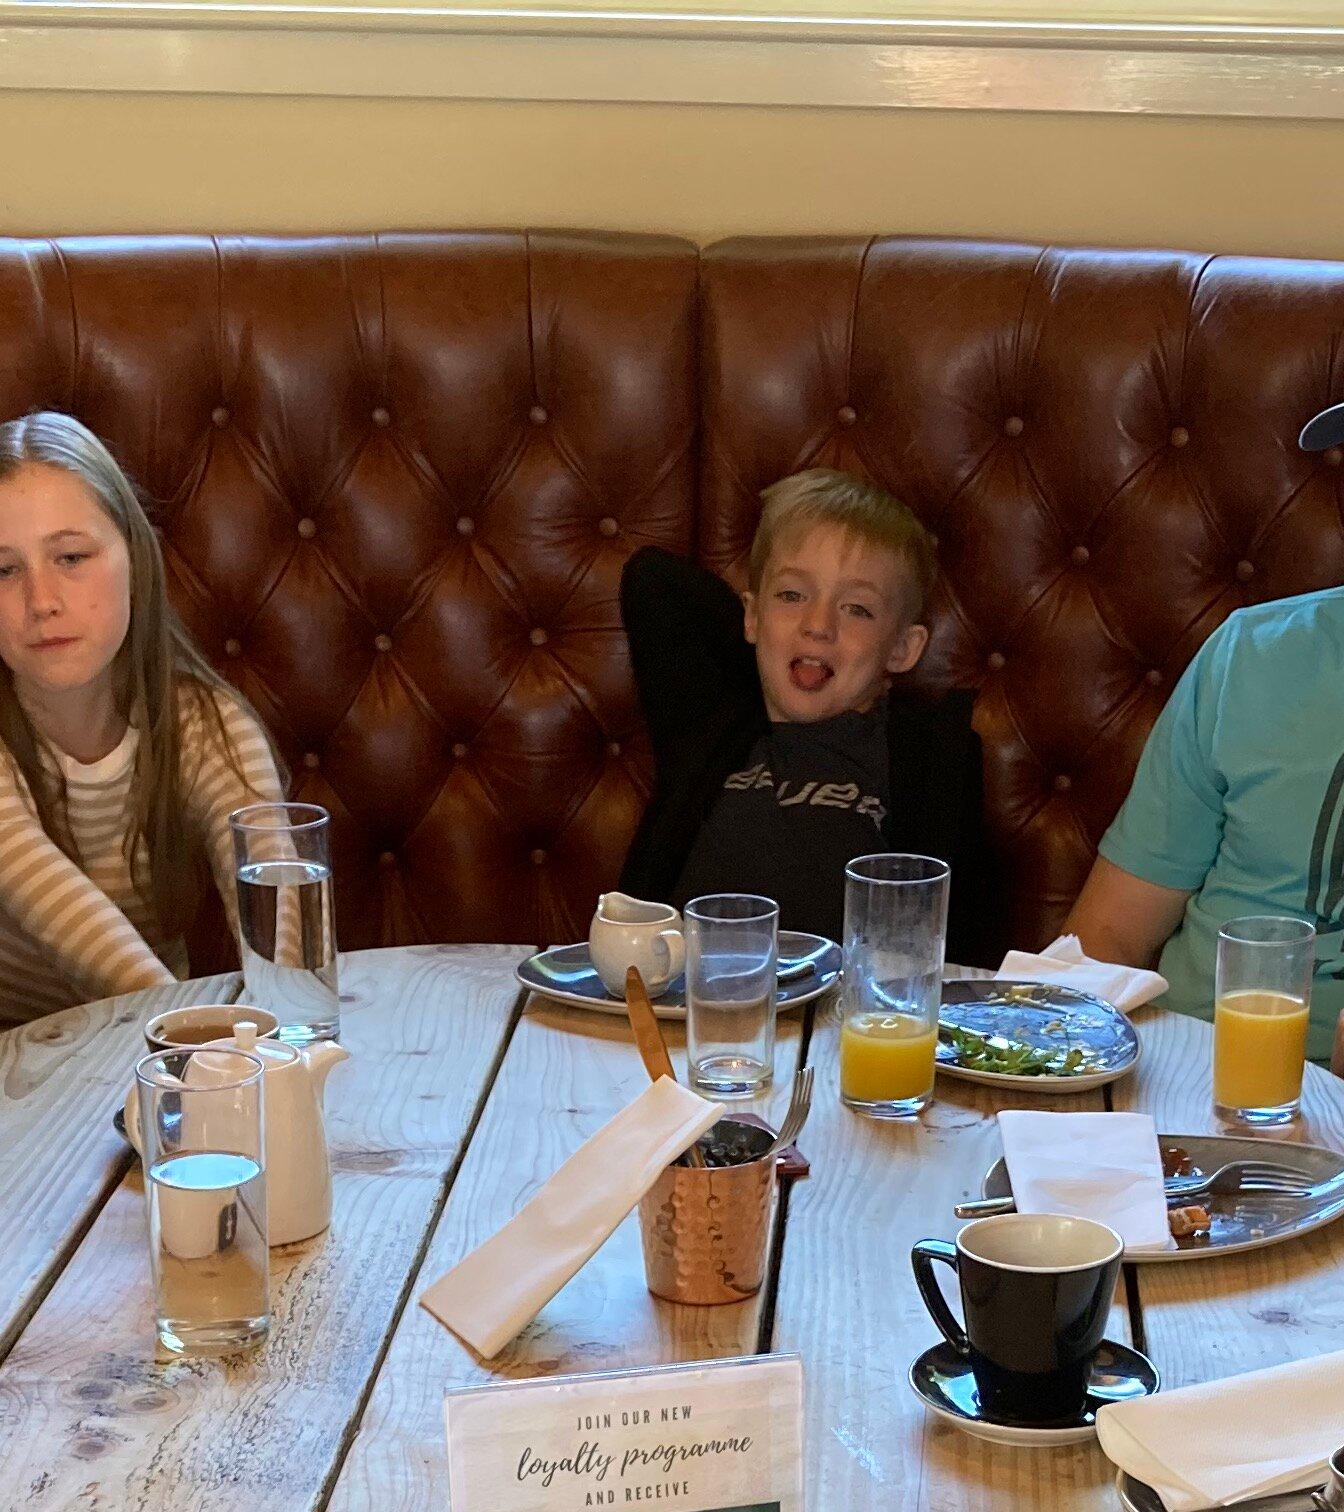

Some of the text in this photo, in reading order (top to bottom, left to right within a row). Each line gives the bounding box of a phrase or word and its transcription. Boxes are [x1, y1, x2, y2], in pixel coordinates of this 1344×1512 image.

[577, 1406, 693, 1431] JOIN OUR NEW
[516, 1436, 754, 1487] loyalty programme
[585, 1481, 690, 1507] AND RECEIVE
